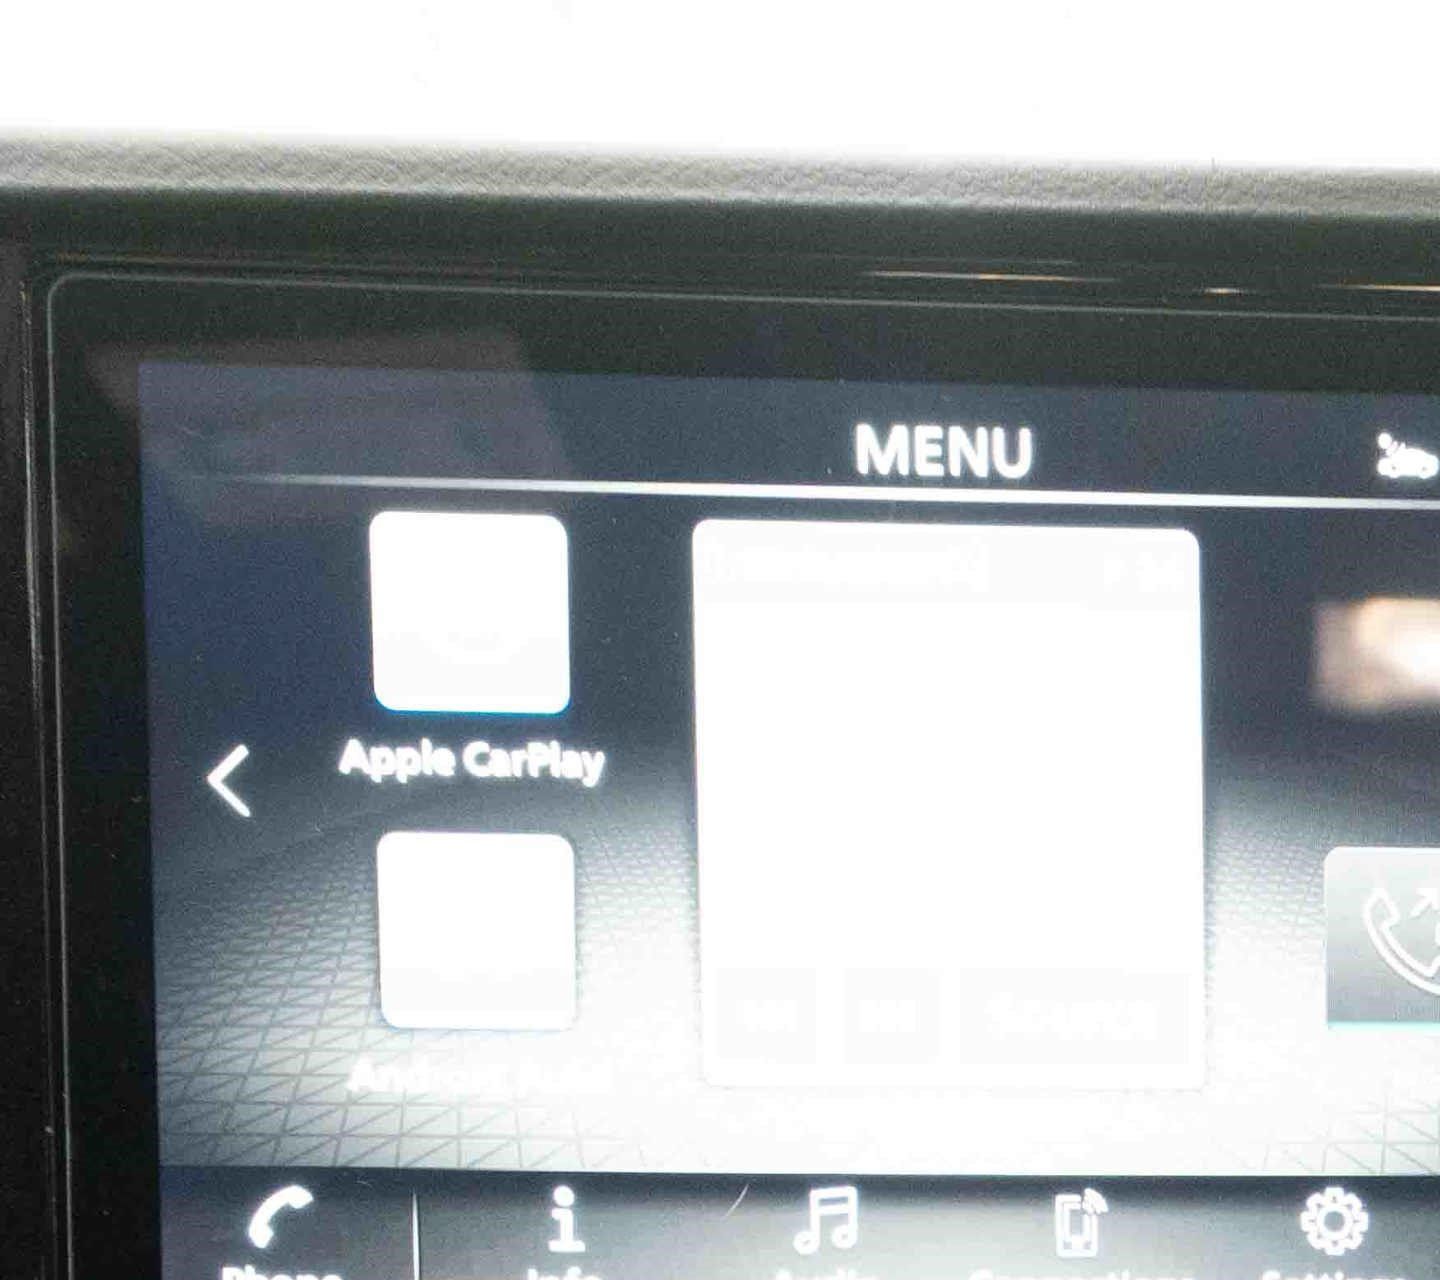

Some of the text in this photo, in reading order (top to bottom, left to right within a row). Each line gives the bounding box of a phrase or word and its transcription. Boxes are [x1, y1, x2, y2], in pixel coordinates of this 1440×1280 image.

[854, 422, 1034, 481] MENU
[339, 738, 606, 788] Apple CarPlay
